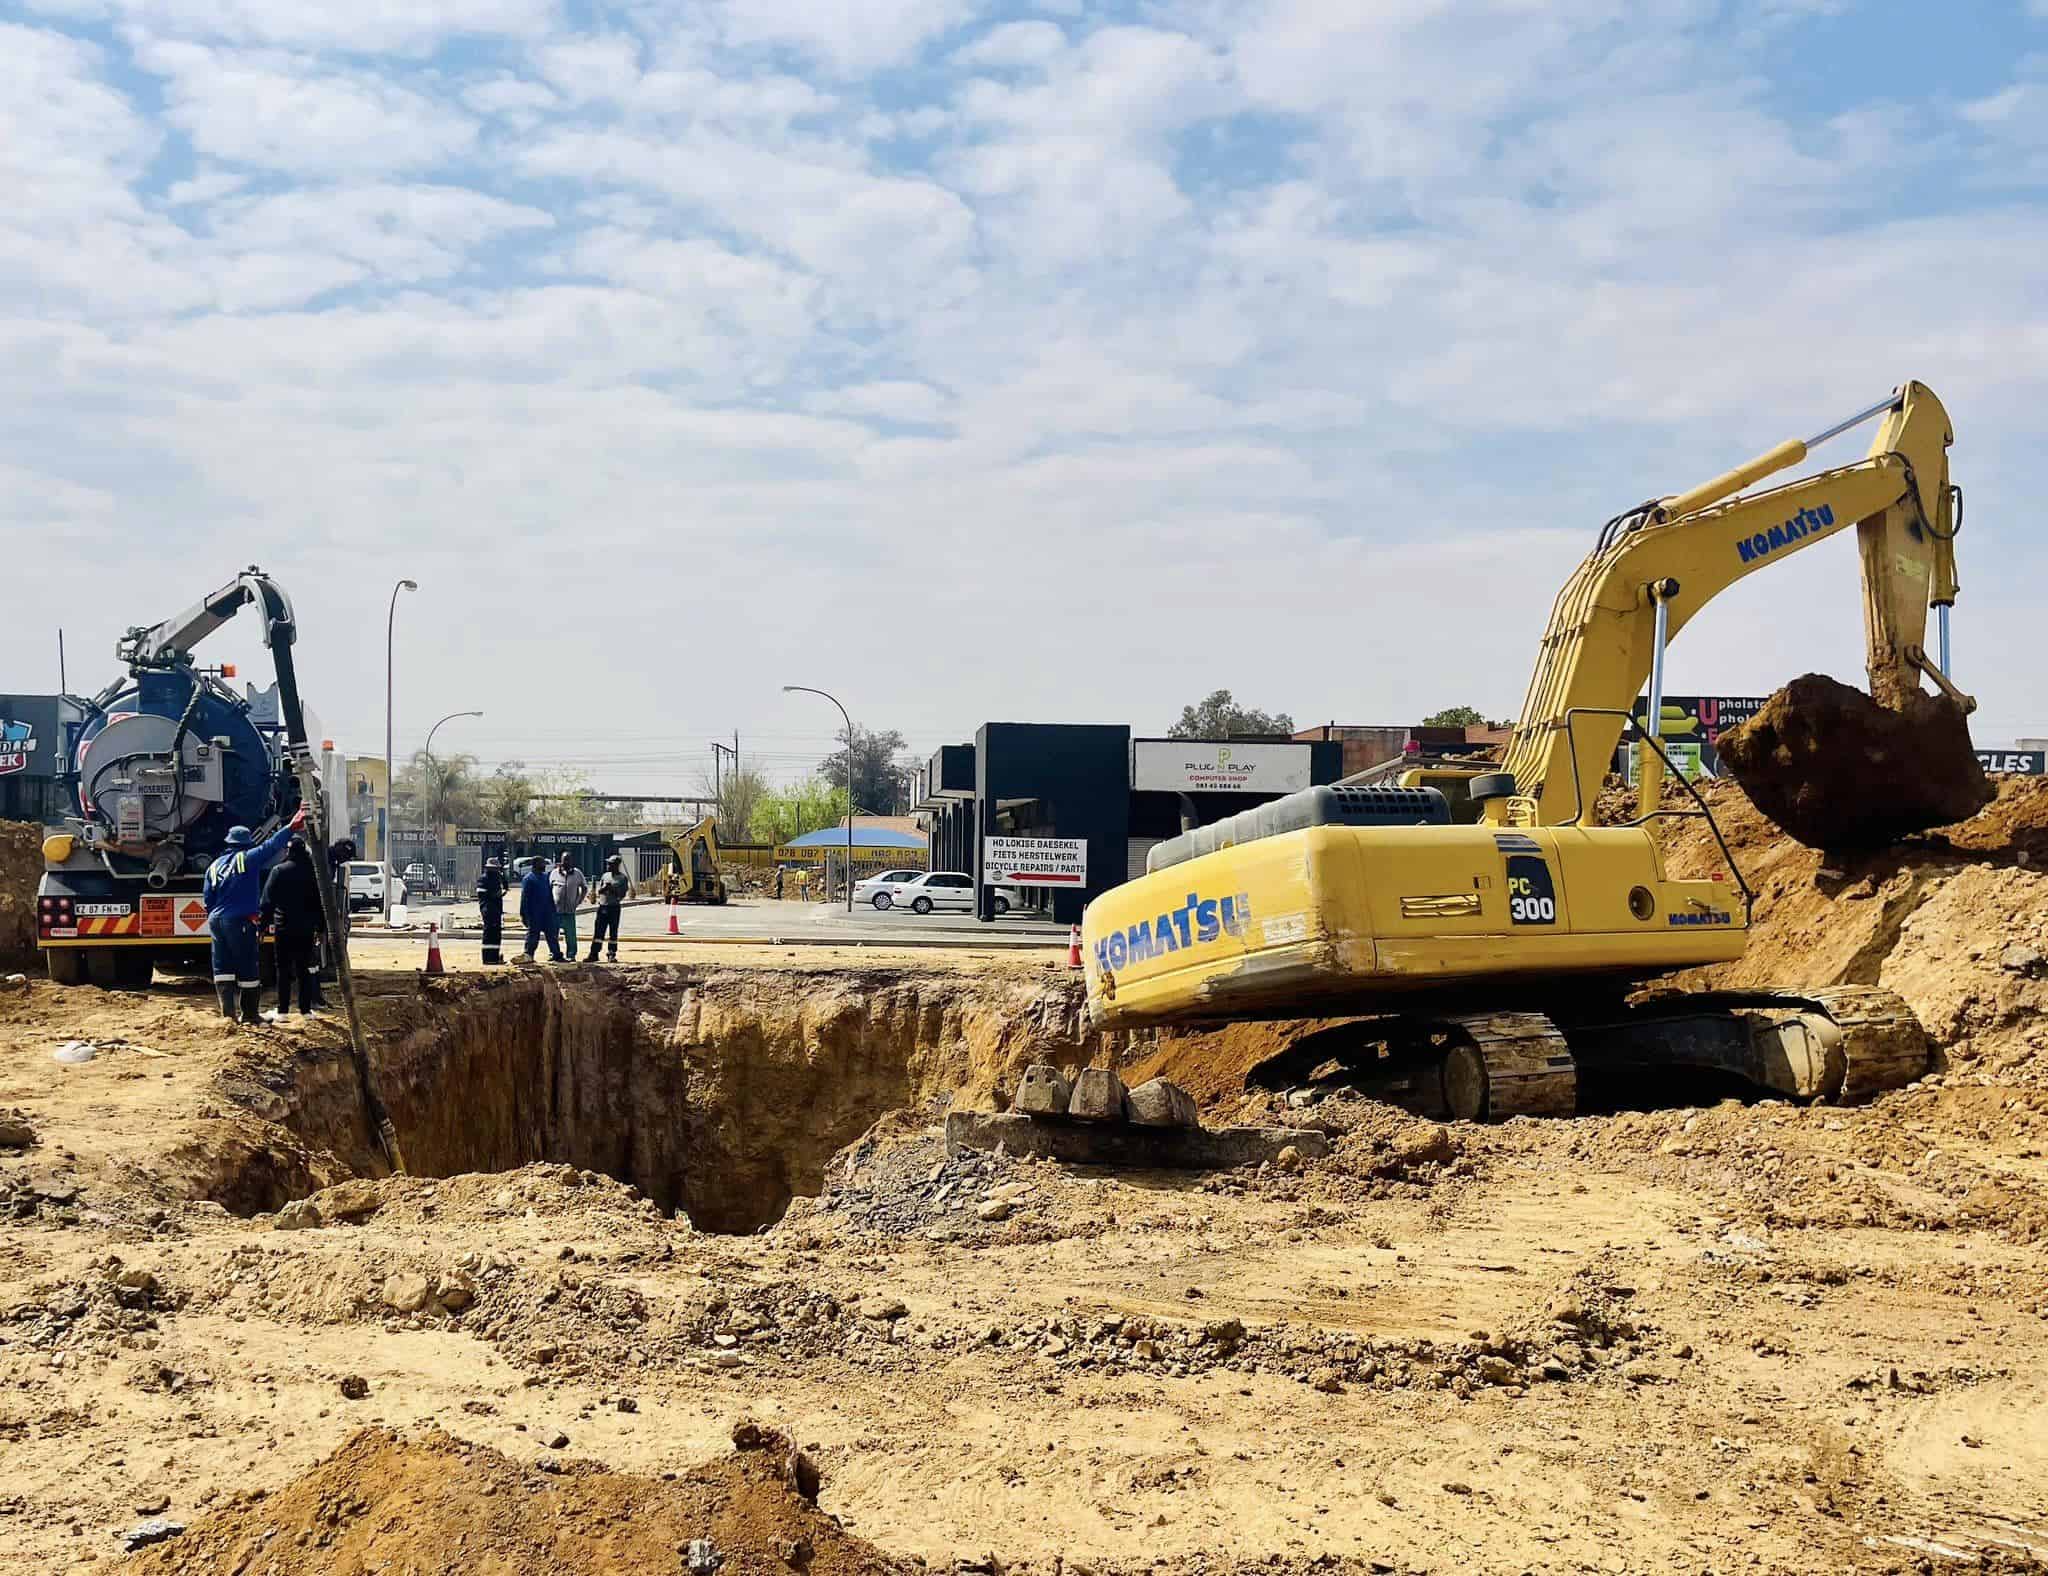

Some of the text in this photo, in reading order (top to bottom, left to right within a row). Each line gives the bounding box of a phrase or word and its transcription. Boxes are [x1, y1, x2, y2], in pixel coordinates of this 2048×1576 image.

[1736, 504, 1834, 563] KOMATSU
[1184, 763, 1215, 771] PLUG
[1228, 763, 1257, 772] PLAY
[993, 850, 1078, 862] FIETS HERSTELWERK
[1020, 863, 1054, 872] REPAIRS
[1061, 864, 1086, 873] PARTS
[1508, 877, 1532, 896] PC
[1511, 897, 1555, 921] 300
[1094, 892, 1251, 972] KOMATSU
